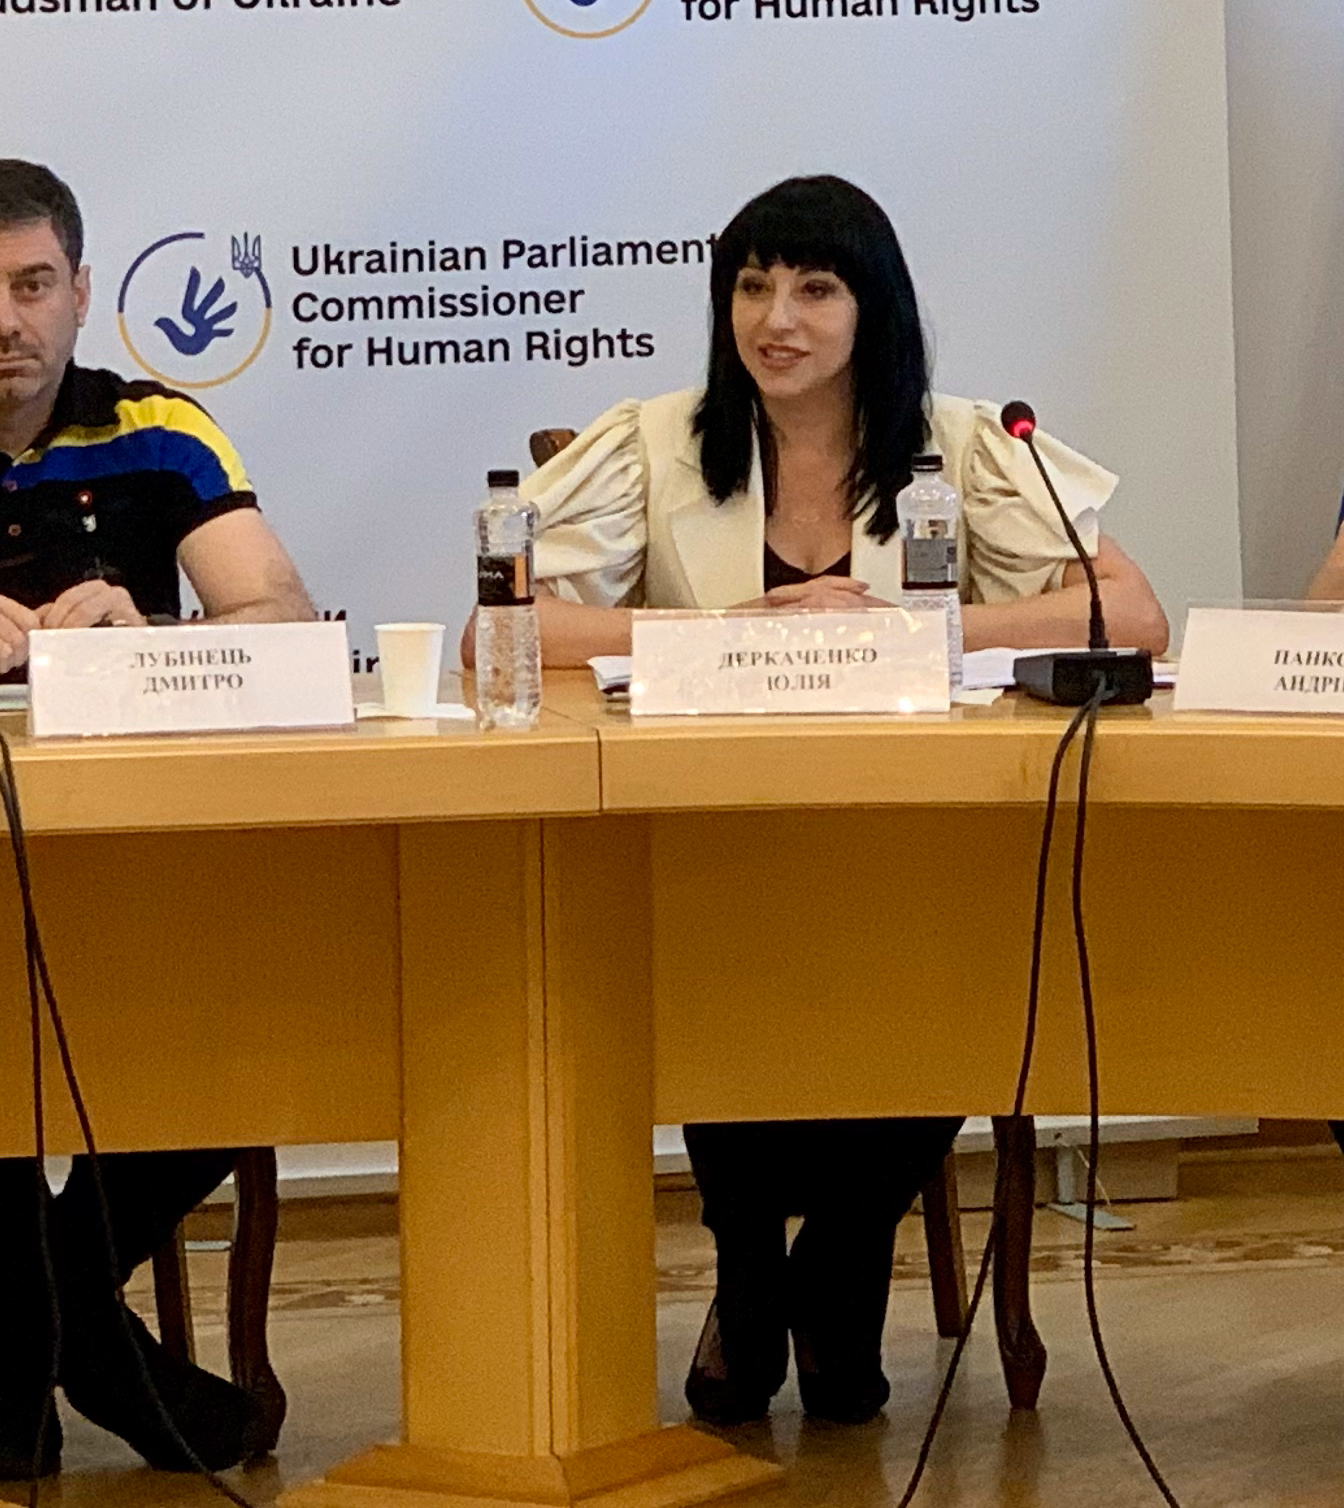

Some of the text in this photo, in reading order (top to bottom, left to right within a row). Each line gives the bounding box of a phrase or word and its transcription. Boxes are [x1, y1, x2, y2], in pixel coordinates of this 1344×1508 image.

[292, 241, 487, 276] Ukrainian
[292, 284, 586, 323] Commissioner
[292, 327, 655, 369] for Human Rights
[129, 648, 252, 668] ЛУБІНЕЦЬ
[718, 647, 877, 670] ДЕРКАЧЕНКО
[142, 673, 243, 695] ДМИТРО
[766, 673, 831, 691] ЮЛІЯ
